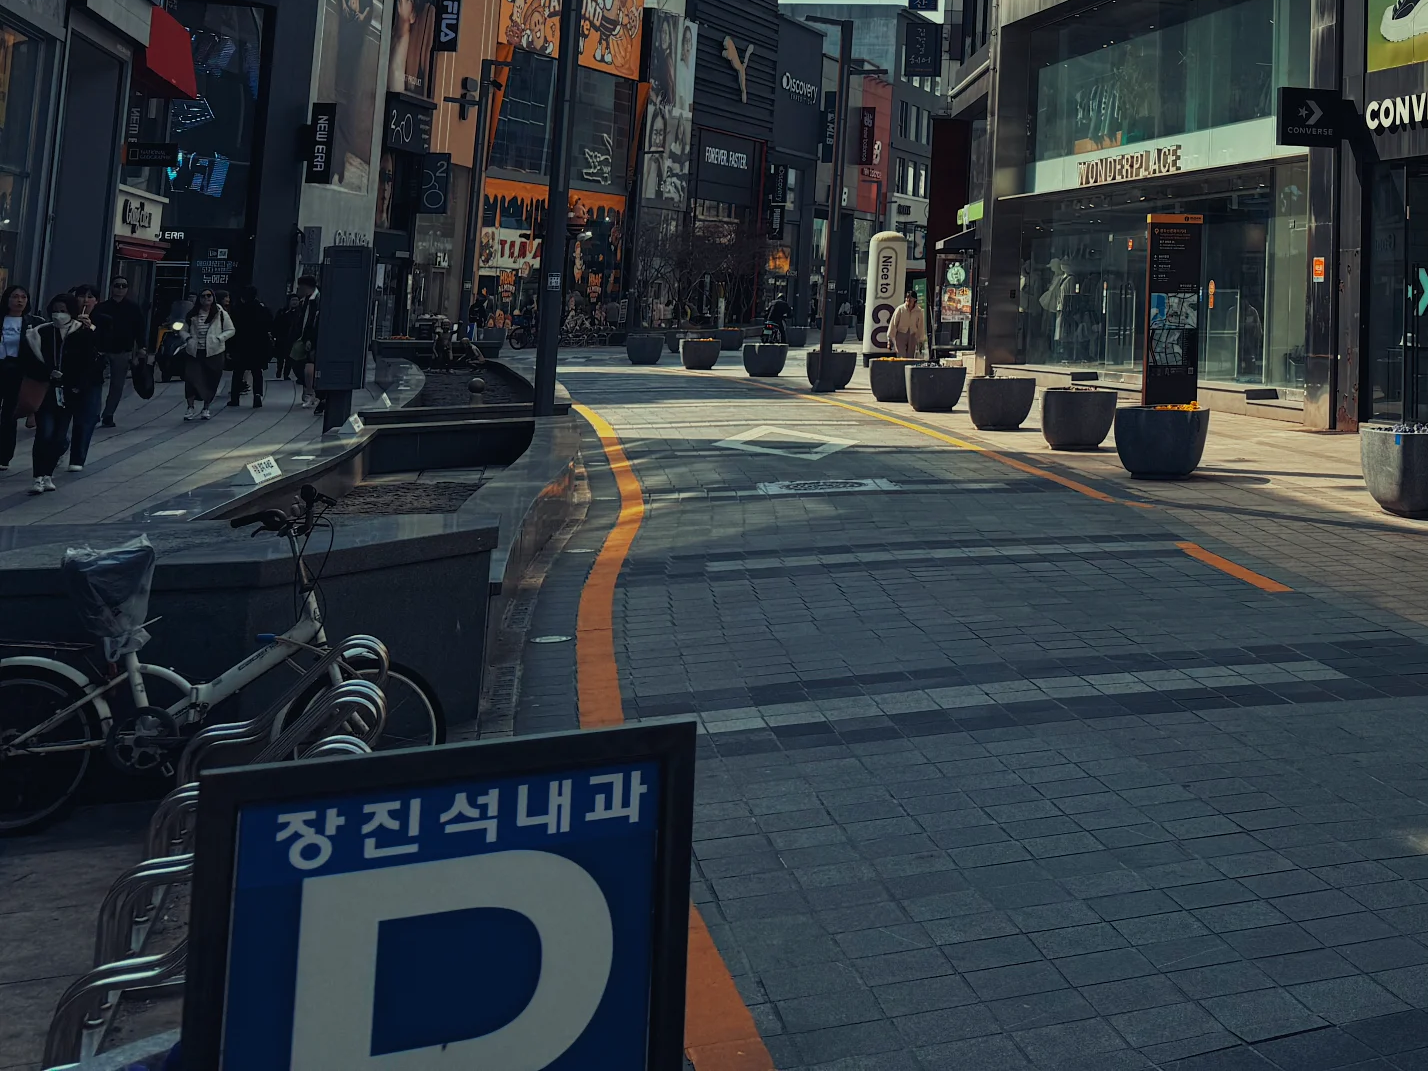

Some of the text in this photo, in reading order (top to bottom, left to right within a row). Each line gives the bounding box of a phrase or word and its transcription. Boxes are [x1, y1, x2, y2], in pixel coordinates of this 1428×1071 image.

[440, 0, 459, 43] FILA
[783, 72, 818, 104] Discovery
[312, 115, 329, 172] NEW ERA
[826, 123, 836, 146] MLB
[1287, 126, 1334, 137] CONVERSE
[705, 146, 748, 170] FOREVER. FASTER.
[1077, 144, 1182, 186] WONDERPLACE
[203, 274, 229, 284] 뉴에라
[879, 255, 893, 294] Nice to
[870, 303, 897, 349] CU
[275, 769, 649, 871] 장진석내과
[289, 848, 614, 1071] P
